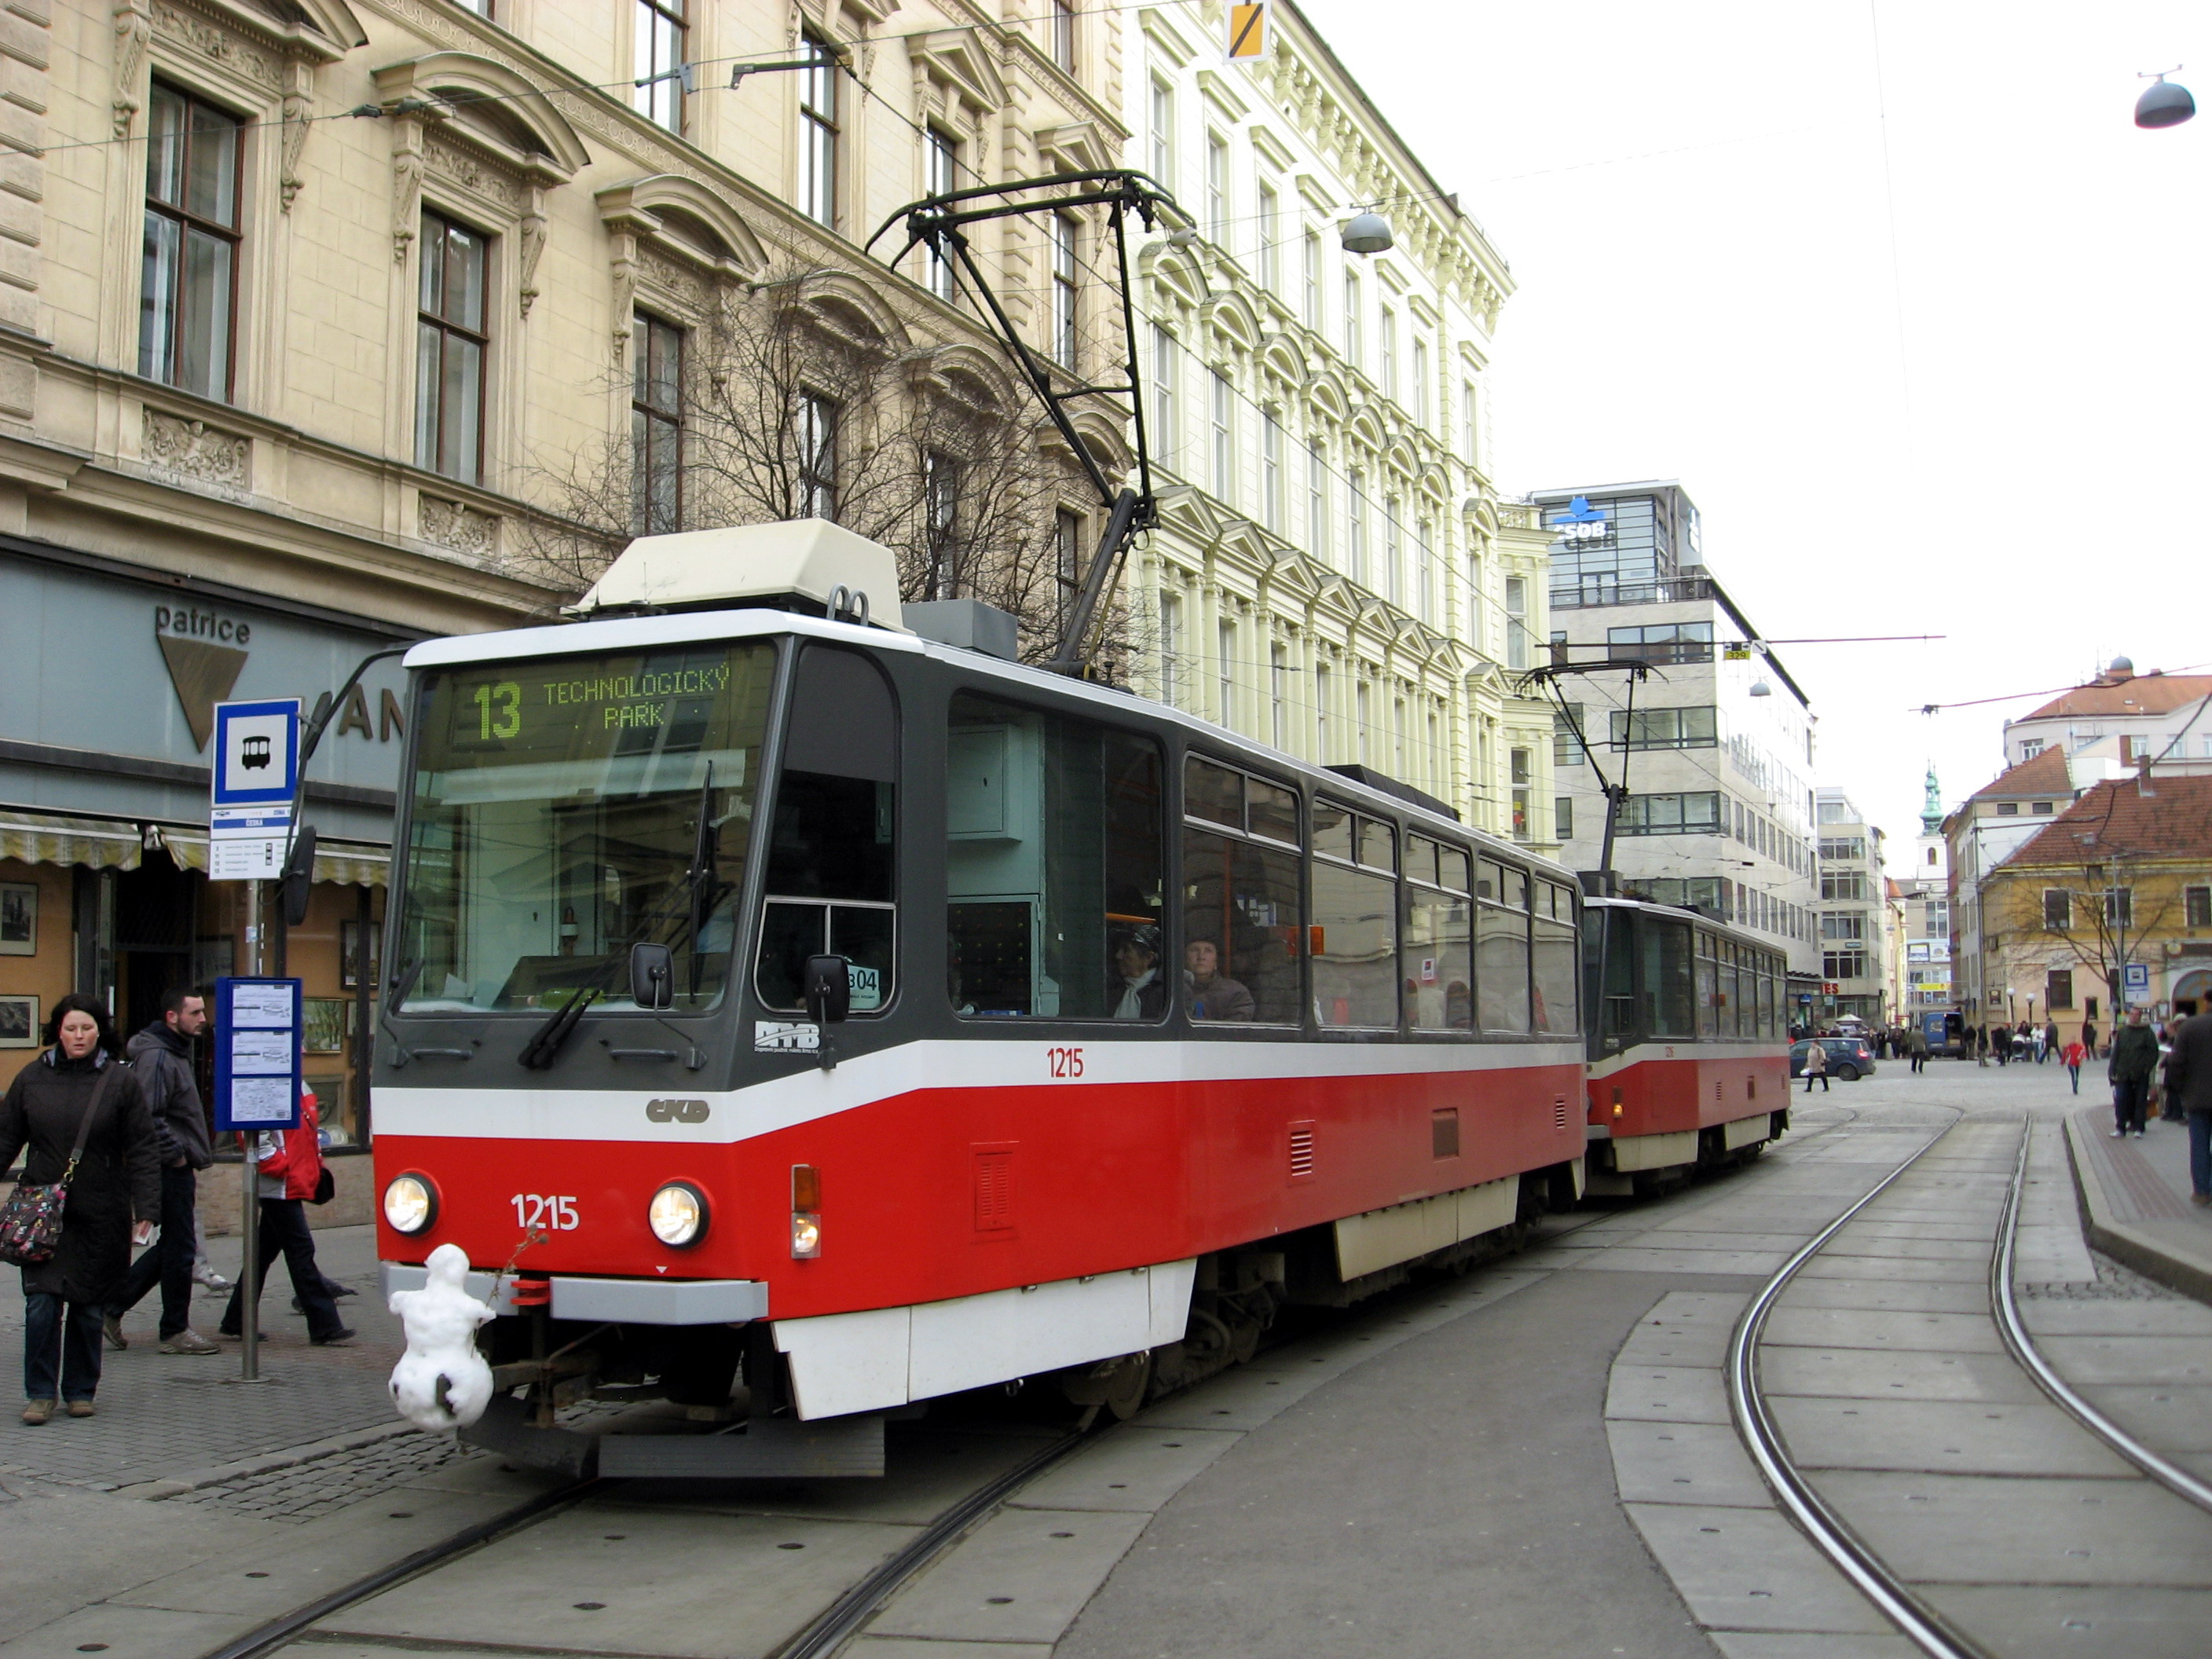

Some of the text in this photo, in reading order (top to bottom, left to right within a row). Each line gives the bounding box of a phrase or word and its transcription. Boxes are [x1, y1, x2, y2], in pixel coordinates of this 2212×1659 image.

[156, 606, 250, 644] patrice
[544, 661, 730, 705] TECHNOLOGICKÝ
[474, 682, 520, 740] 13
[603, 701, 665, 729] PARK
[1047, 1047, 1084, 1078] 1215
[511, 1193, 580, 1231] 1215
